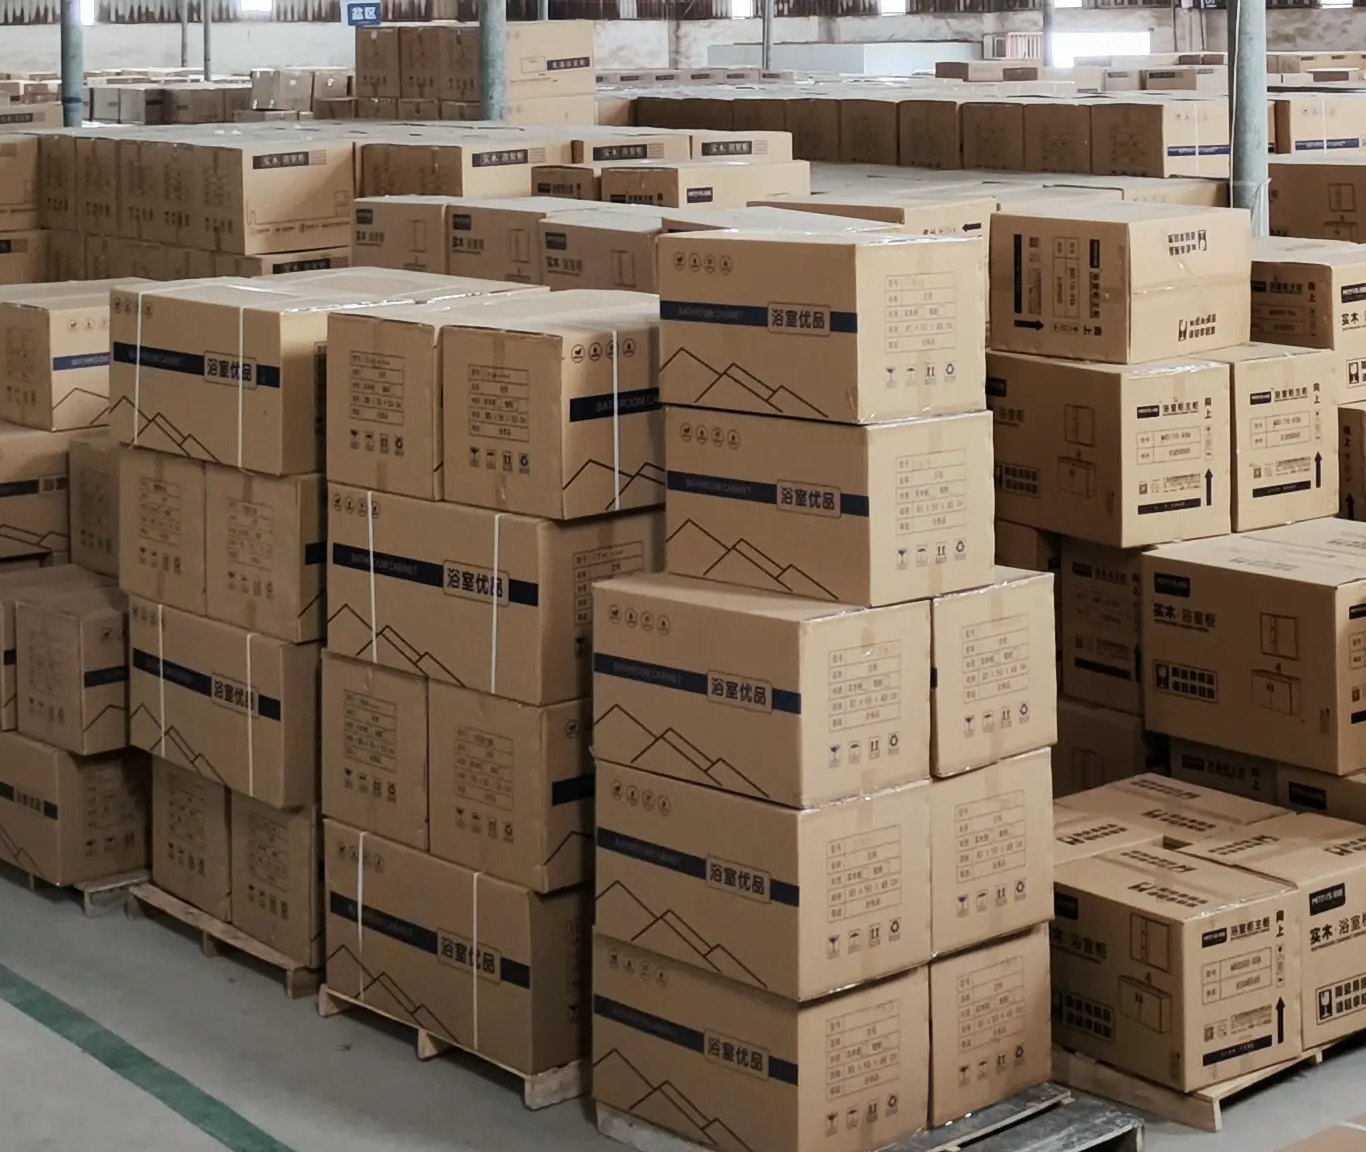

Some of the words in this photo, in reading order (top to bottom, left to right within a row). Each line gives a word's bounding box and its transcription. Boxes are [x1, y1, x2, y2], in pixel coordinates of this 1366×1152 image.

[771, 308, 825, 330] 浴室优品
[781, 487, 835, 511] 浴室优品
[711, 677, 766, 706] 浴室优品
[710, 862, 765, 896] 浴室优品
[707, 1039, 763, 1073] 浴室优品
